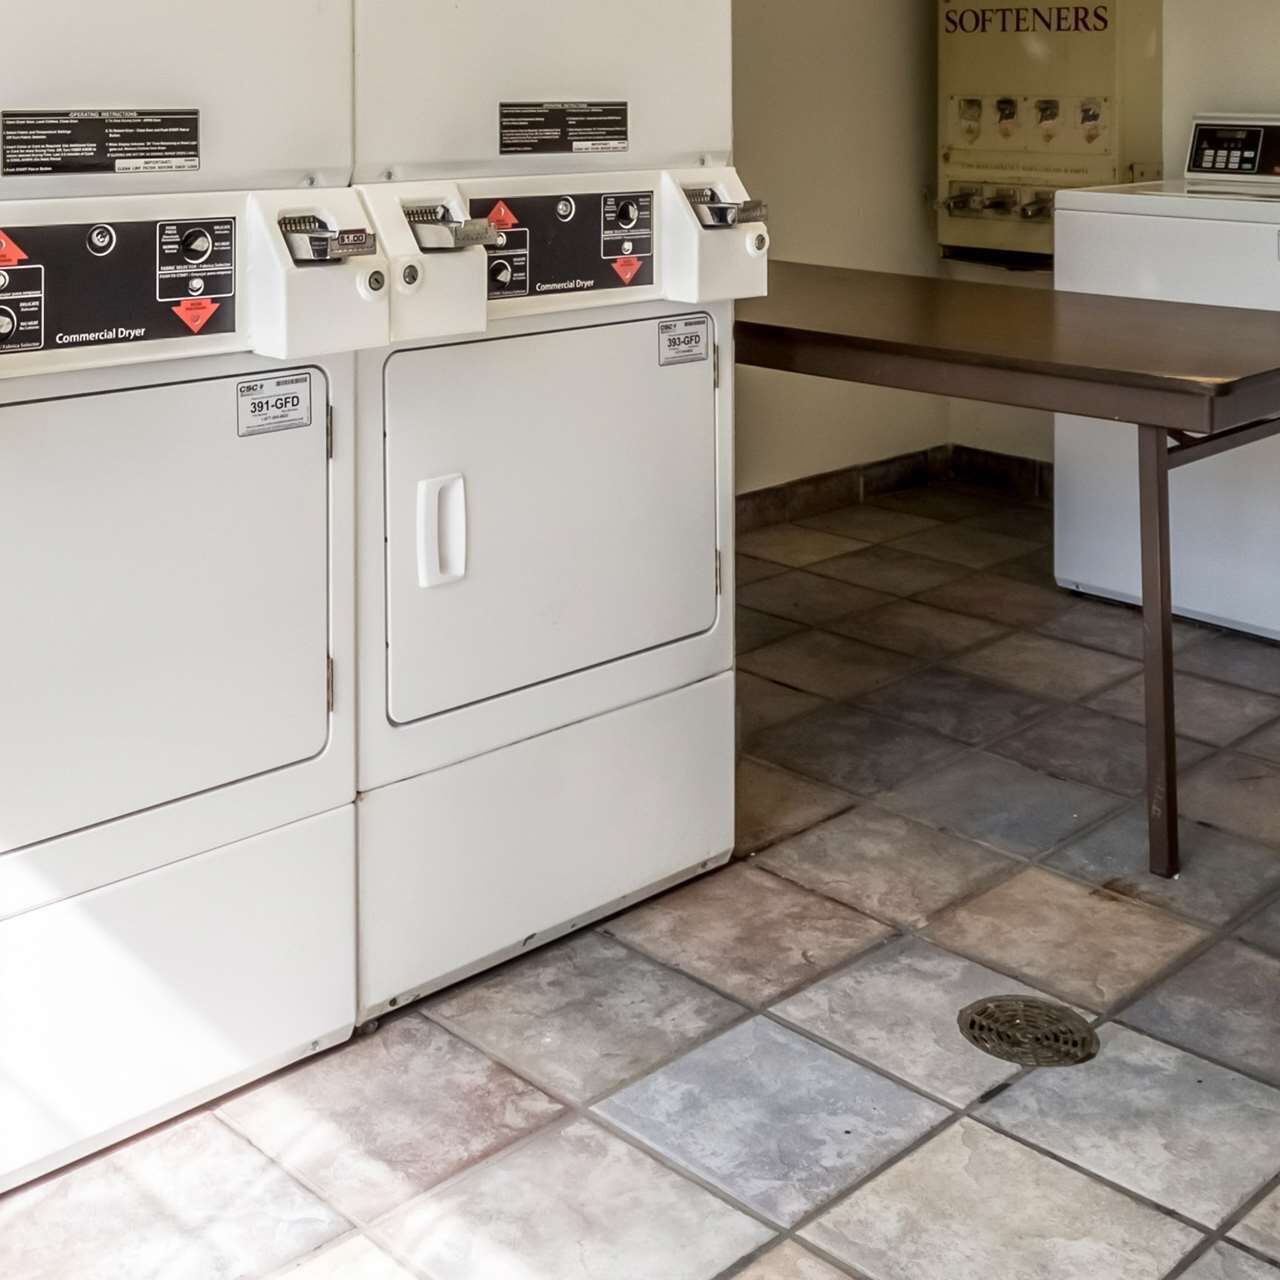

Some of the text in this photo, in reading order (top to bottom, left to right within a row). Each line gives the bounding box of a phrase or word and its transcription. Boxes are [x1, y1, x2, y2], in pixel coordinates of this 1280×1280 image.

[944, 5, 1109, 34] SOFTENERS
[535, 279, 595, 292] Commercial Dryer
[55, 325, 146, 344] Commercial Dryer
[667, 334, 701, 348] 393-GFD
[239, 384, 258, 393] CSC
[250, 395, 300, 413] 391-GFD
